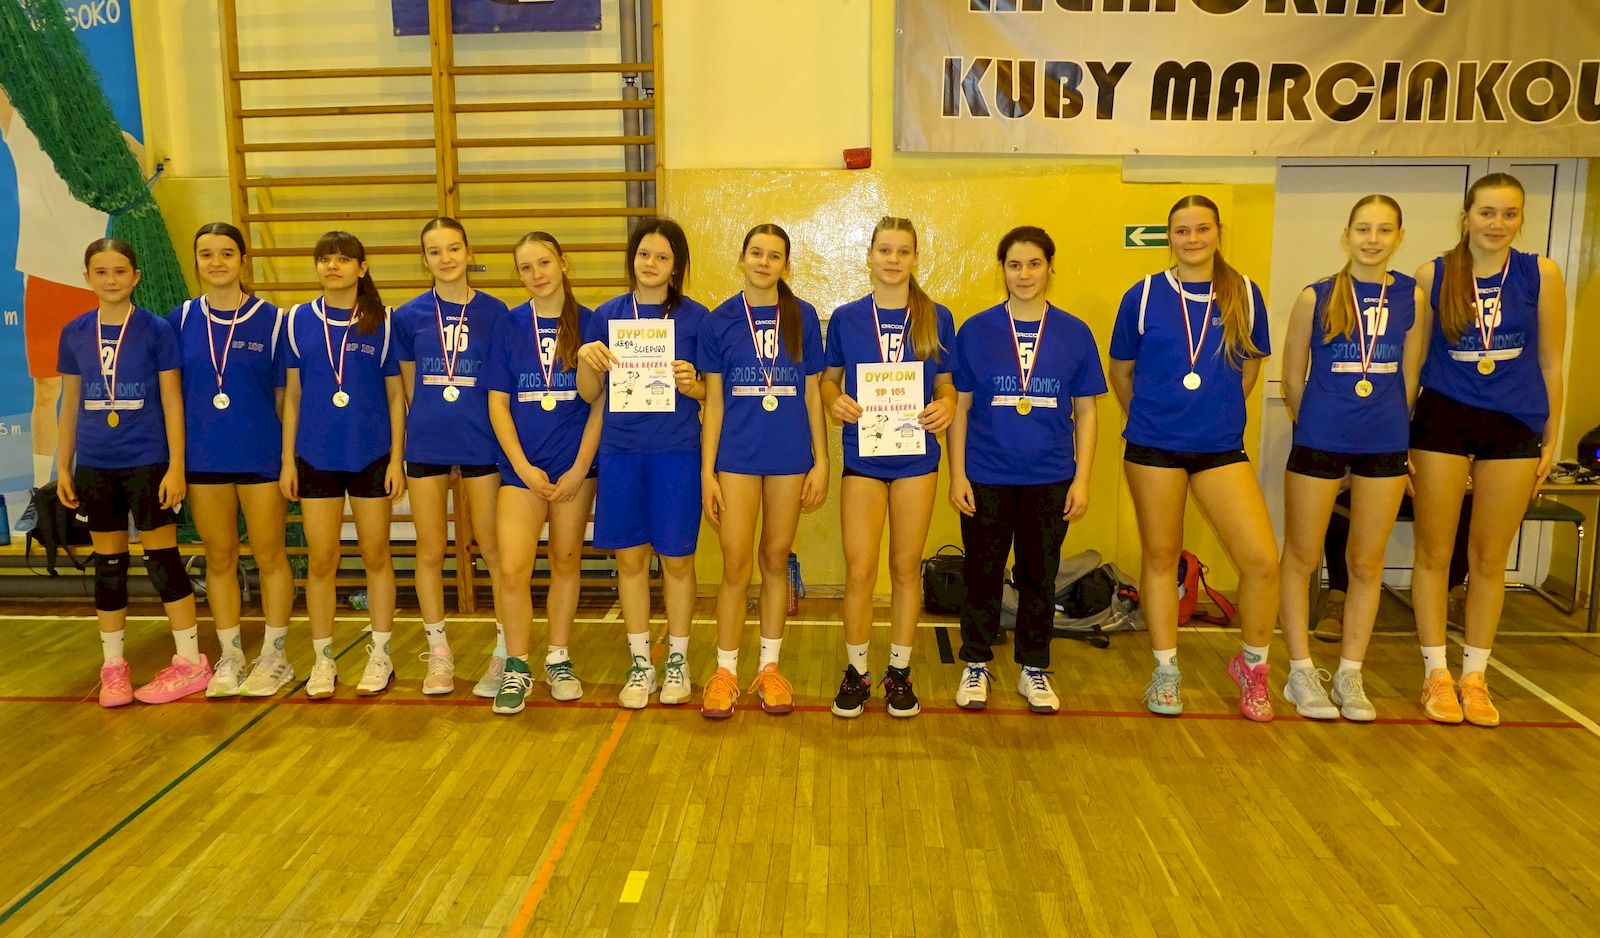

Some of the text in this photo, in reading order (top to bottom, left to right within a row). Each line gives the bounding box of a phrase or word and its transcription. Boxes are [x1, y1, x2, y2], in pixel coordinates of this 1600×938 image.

[942, 57, 1132, 120] KUBY
[4, 310, 18, 325] m
[443, 324, 469, 352] 16
[617, 328, 667, 339] DYPLOM
[755, 329, 779, 359] 18
[101, 346, 115, 376] 2
[541, 337, 555, 366] 3
[880, 333, 904, 363] 15
[1019, 342, 1034, 370] 5
[864, 370, 916, 382] DYPLOM
[890, 386, 906, 397] 105
[11, 424, 21, 436] m
